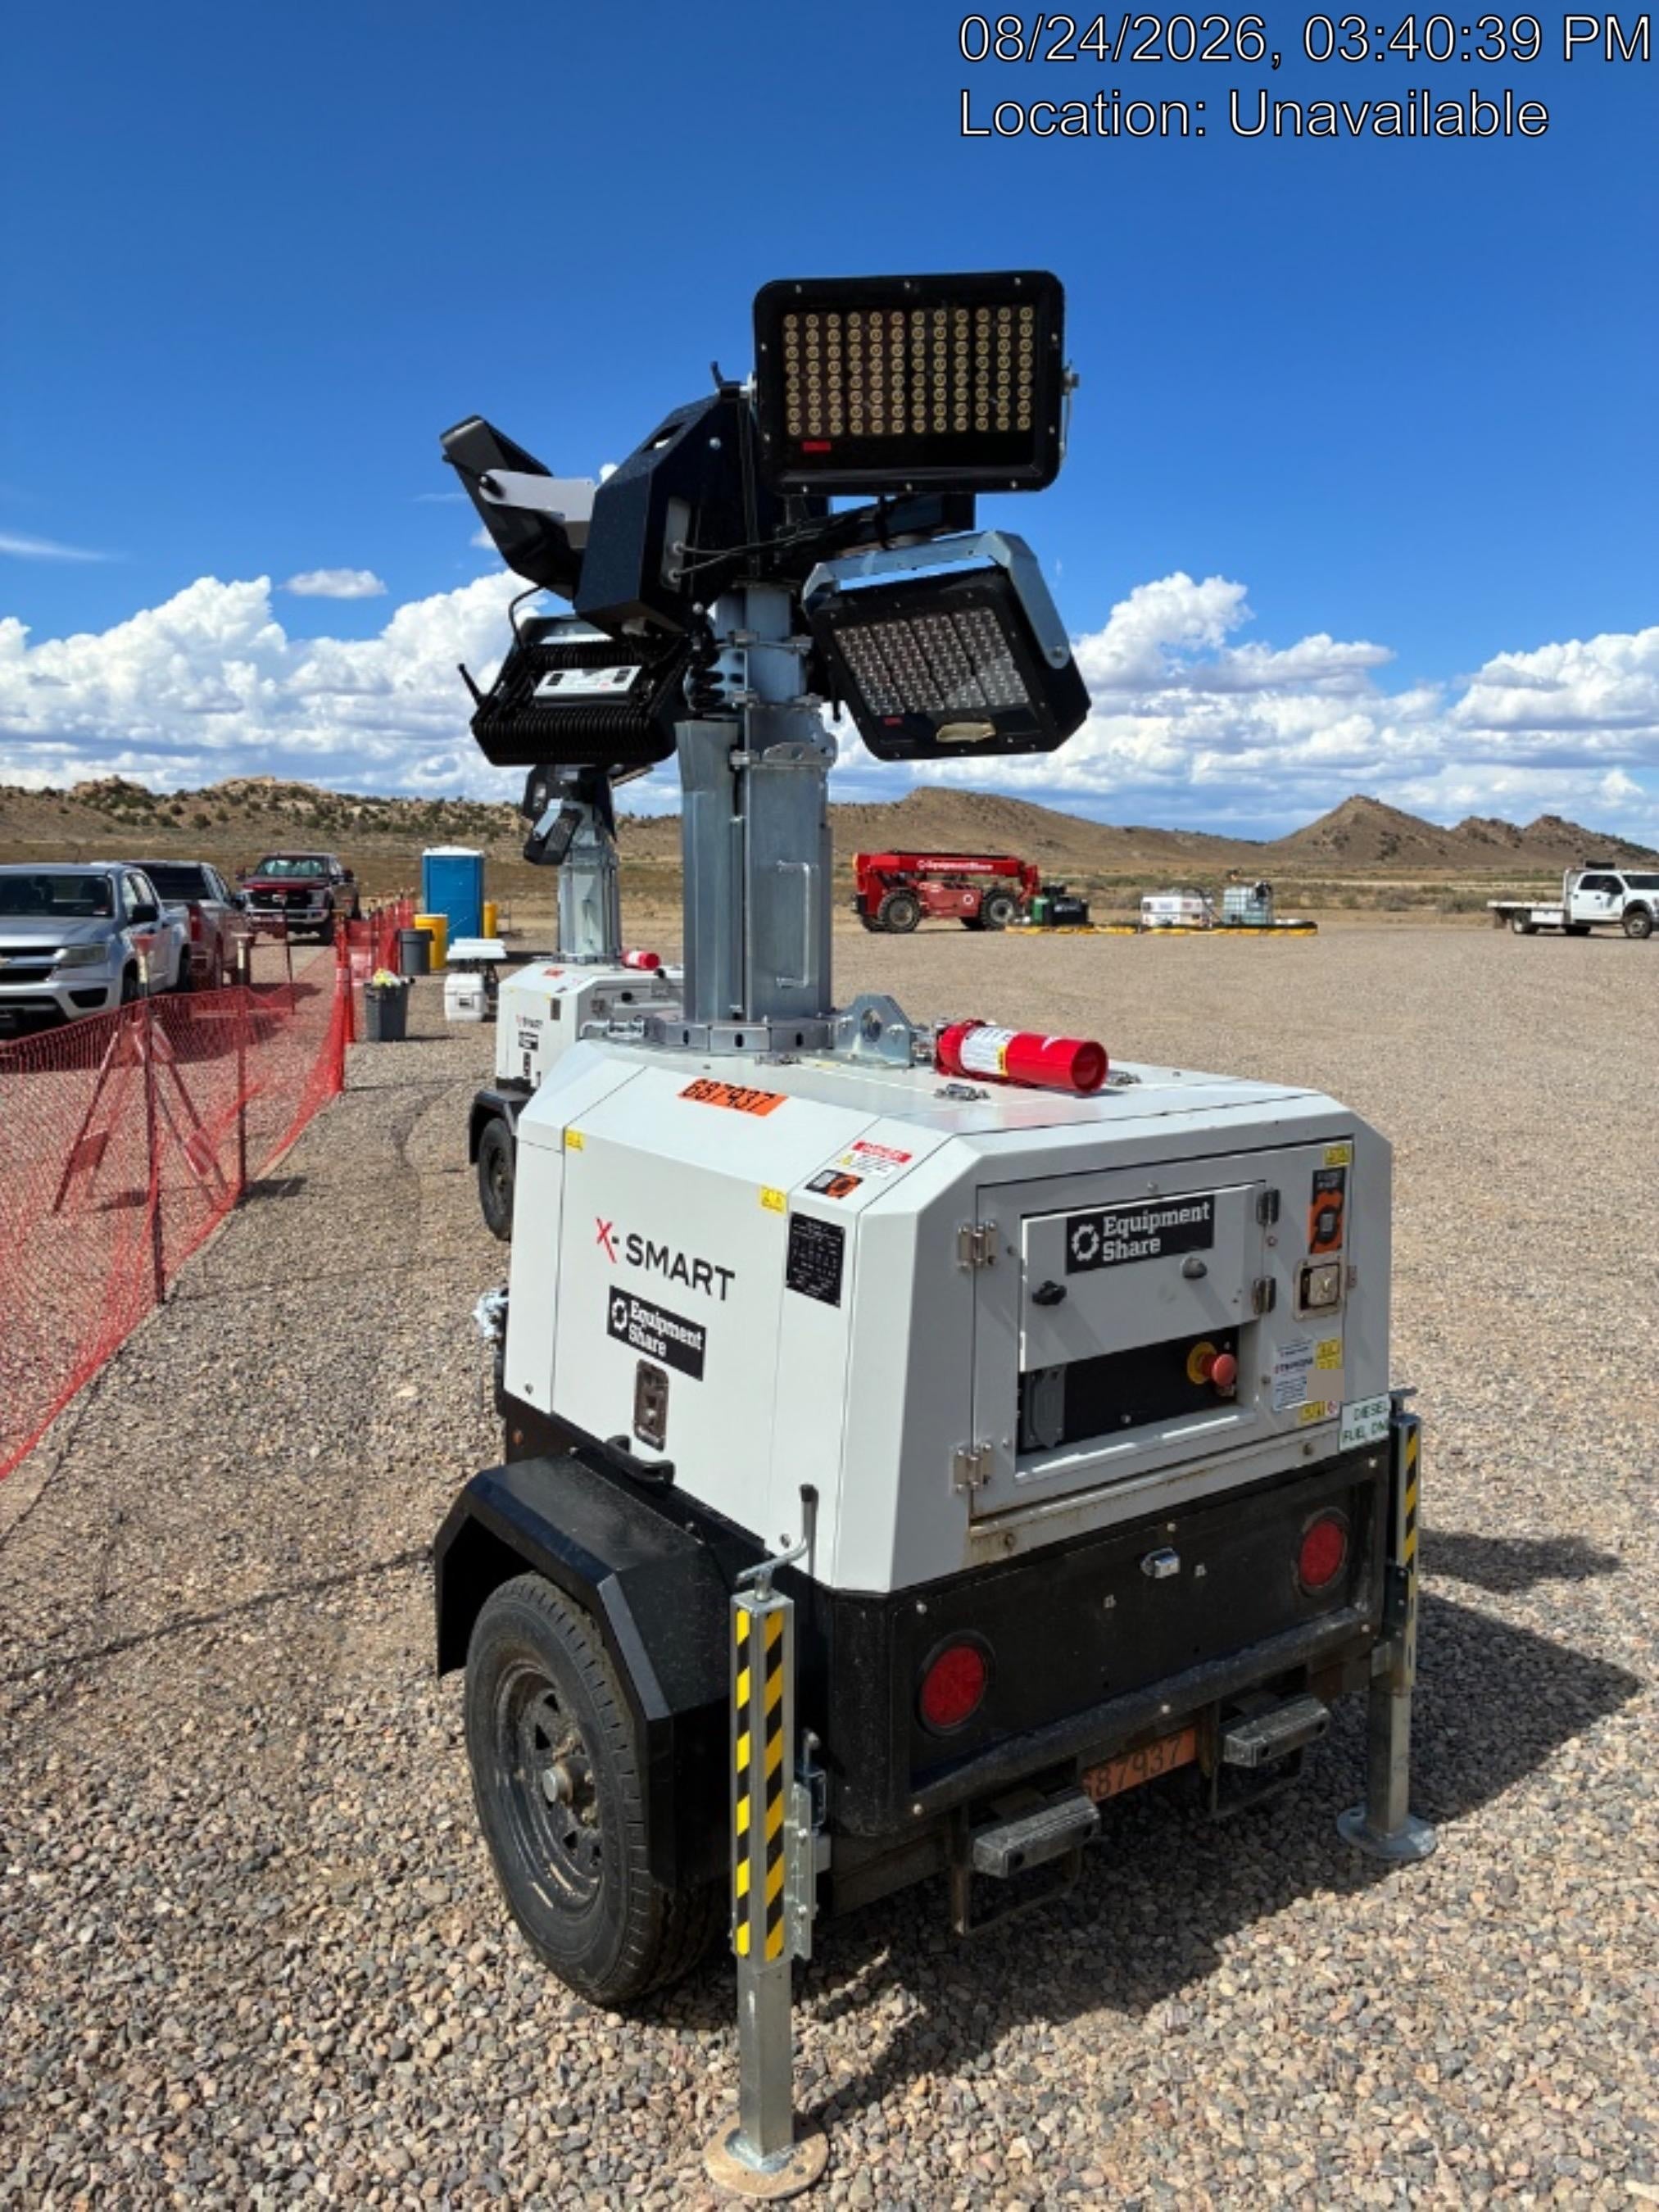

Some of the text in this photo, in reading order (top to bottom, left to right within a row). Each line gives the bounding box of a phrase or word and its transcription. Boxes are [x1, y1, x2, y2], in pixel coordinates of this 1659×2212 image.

[681, 1077, 777, 1112] 687937
[1103, 1201, 1210, 1239] Equipment
[1103, 1237, 1161, 1262] Share
[628, 1322, 667, 1357] Share
[630, 1299, 702, 1351] Equipment
[1353, 1399, 1389, 1421] DIESEL
